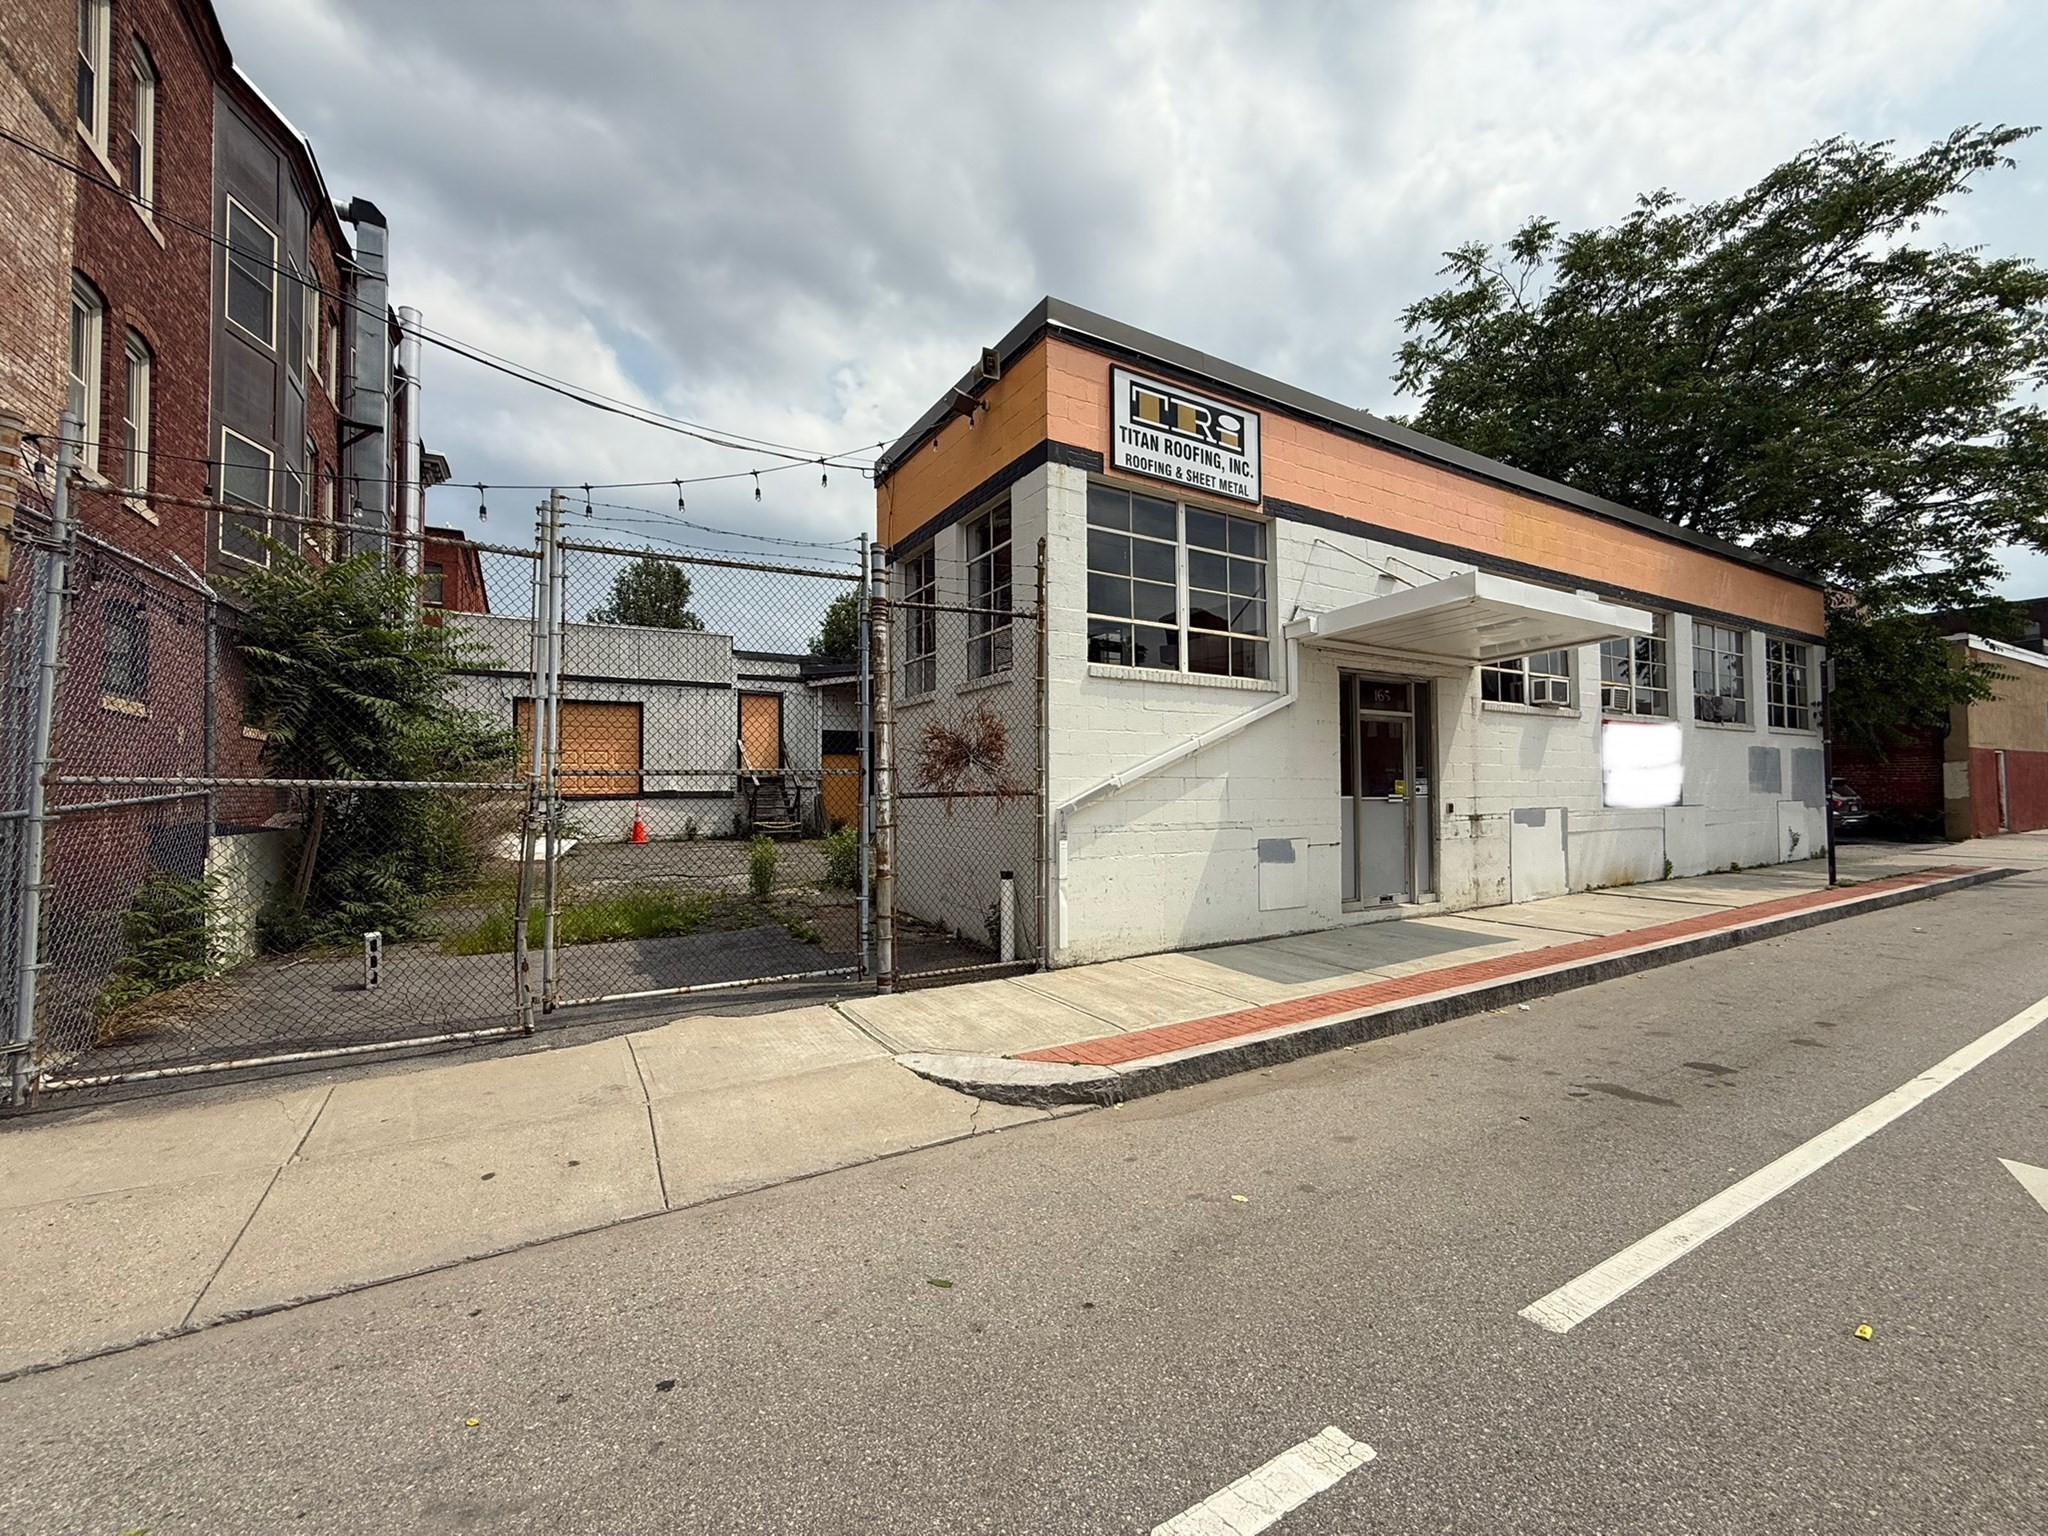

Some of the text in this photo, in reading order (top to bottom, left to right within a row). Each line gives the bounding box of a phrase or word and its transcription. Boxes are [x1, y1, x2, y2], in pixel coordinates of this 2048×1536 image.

[1119, 425, 1254, 478] TITAN ROOFING, INC.
[1125, 453, 1250, 497] ROOFING & SHEET METAL
[1374, 689, 1391, 703] 165
